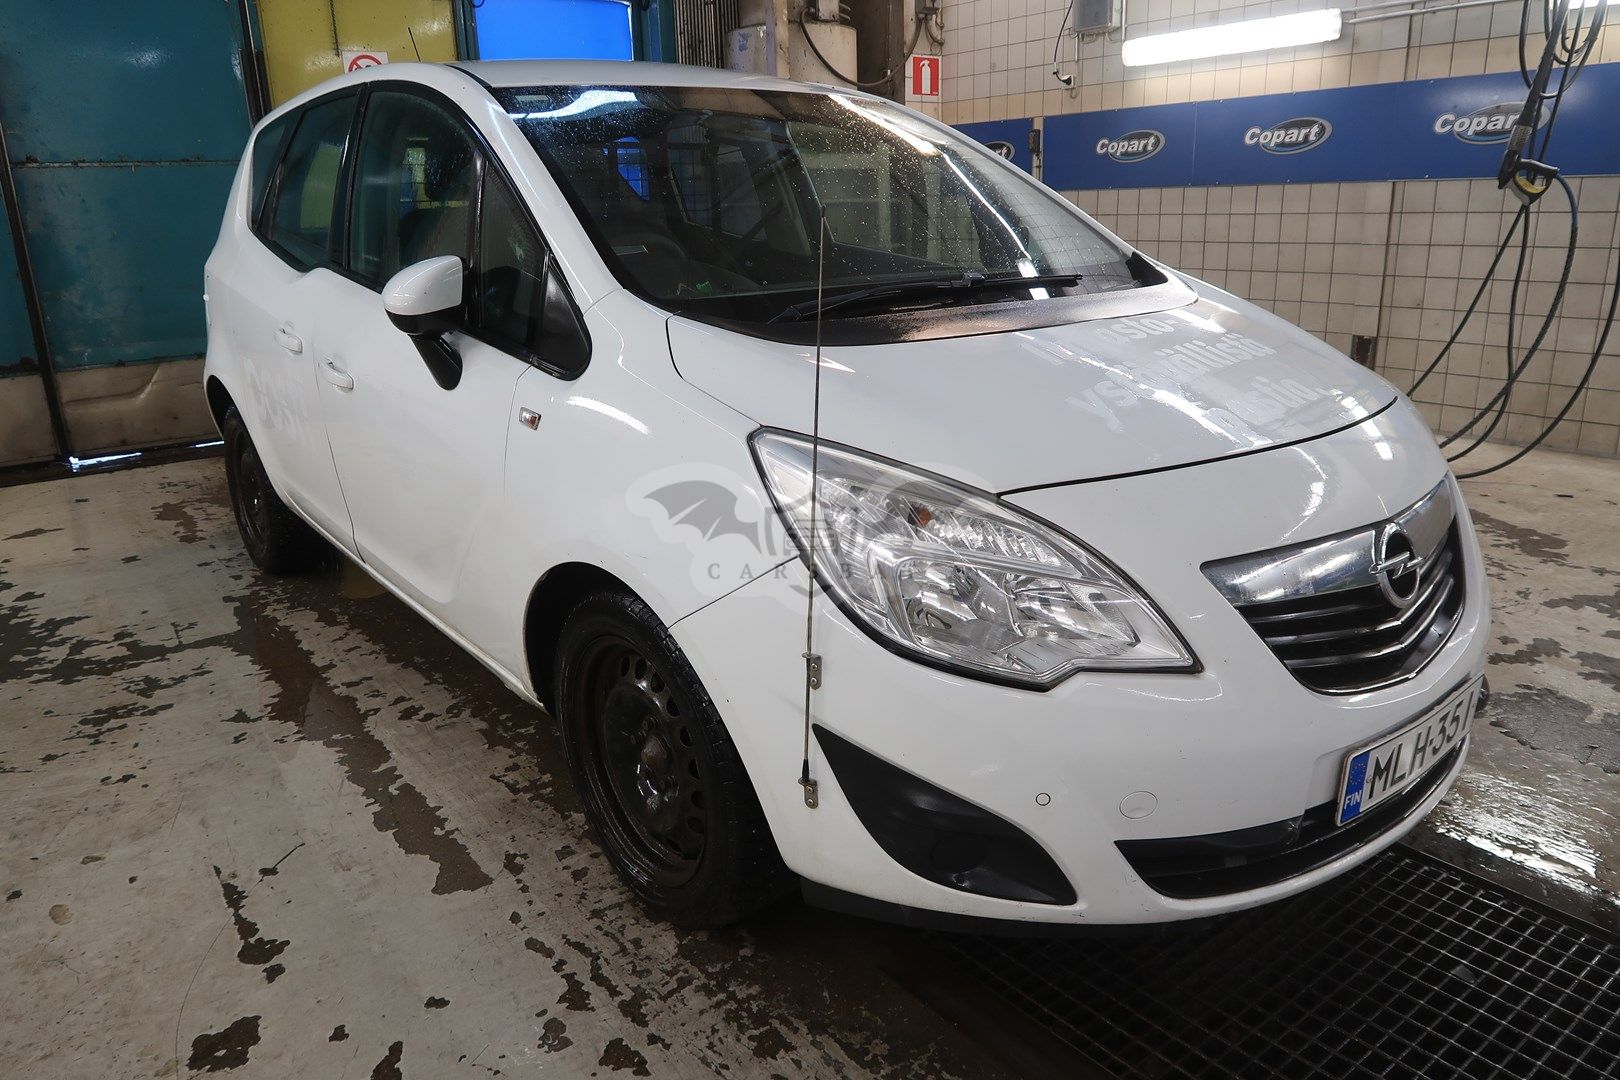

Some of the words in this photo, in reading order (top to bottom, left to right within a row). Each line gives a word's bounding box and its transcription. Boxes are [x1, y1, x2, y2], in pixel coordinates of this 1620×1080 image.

[1244, 122, 1320, 147] Copart
[1434, 112, 1522, 136] Copar
[1096, 134, 1156, 156] Copart
[1343, 789, 1363, 810] FIN
